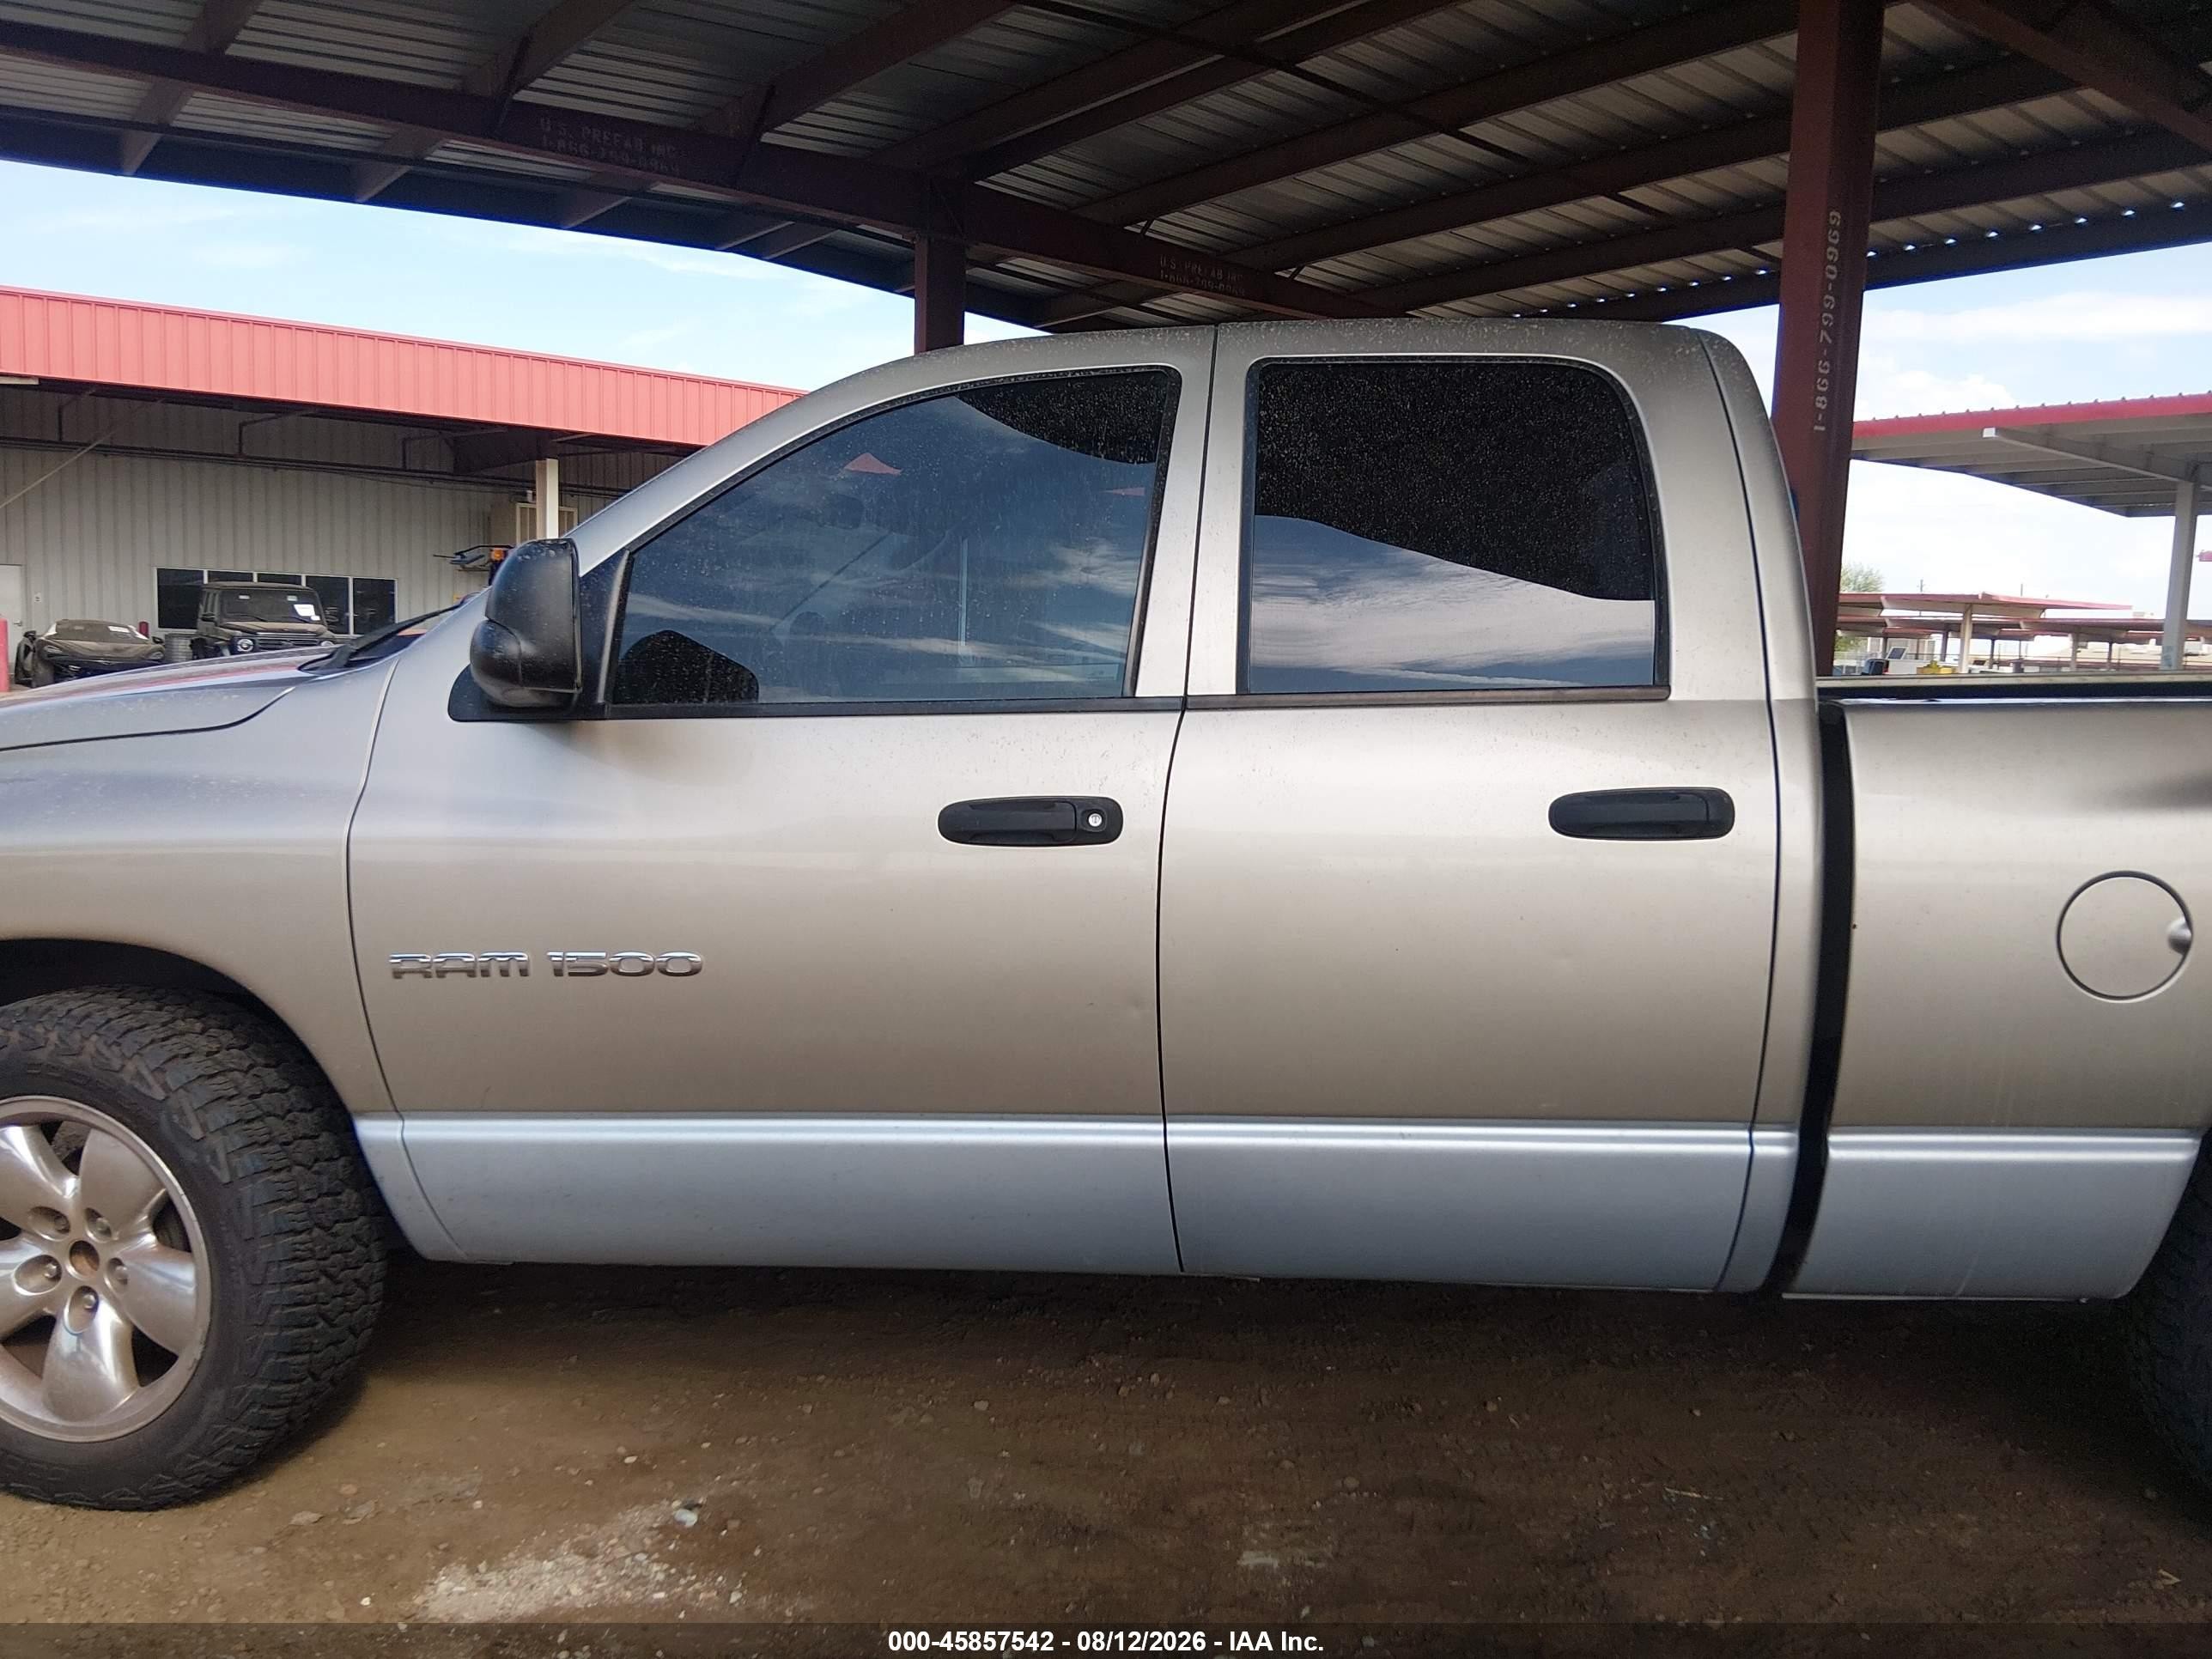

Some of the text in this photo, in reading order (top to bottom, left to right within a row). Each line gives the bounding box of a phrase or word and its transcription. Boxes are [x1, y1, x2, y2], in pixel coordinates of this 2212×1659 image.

[1813, 210, 1842, 431] 1-866-799-0969
[389, 951, 703, 979] RAM 1500
